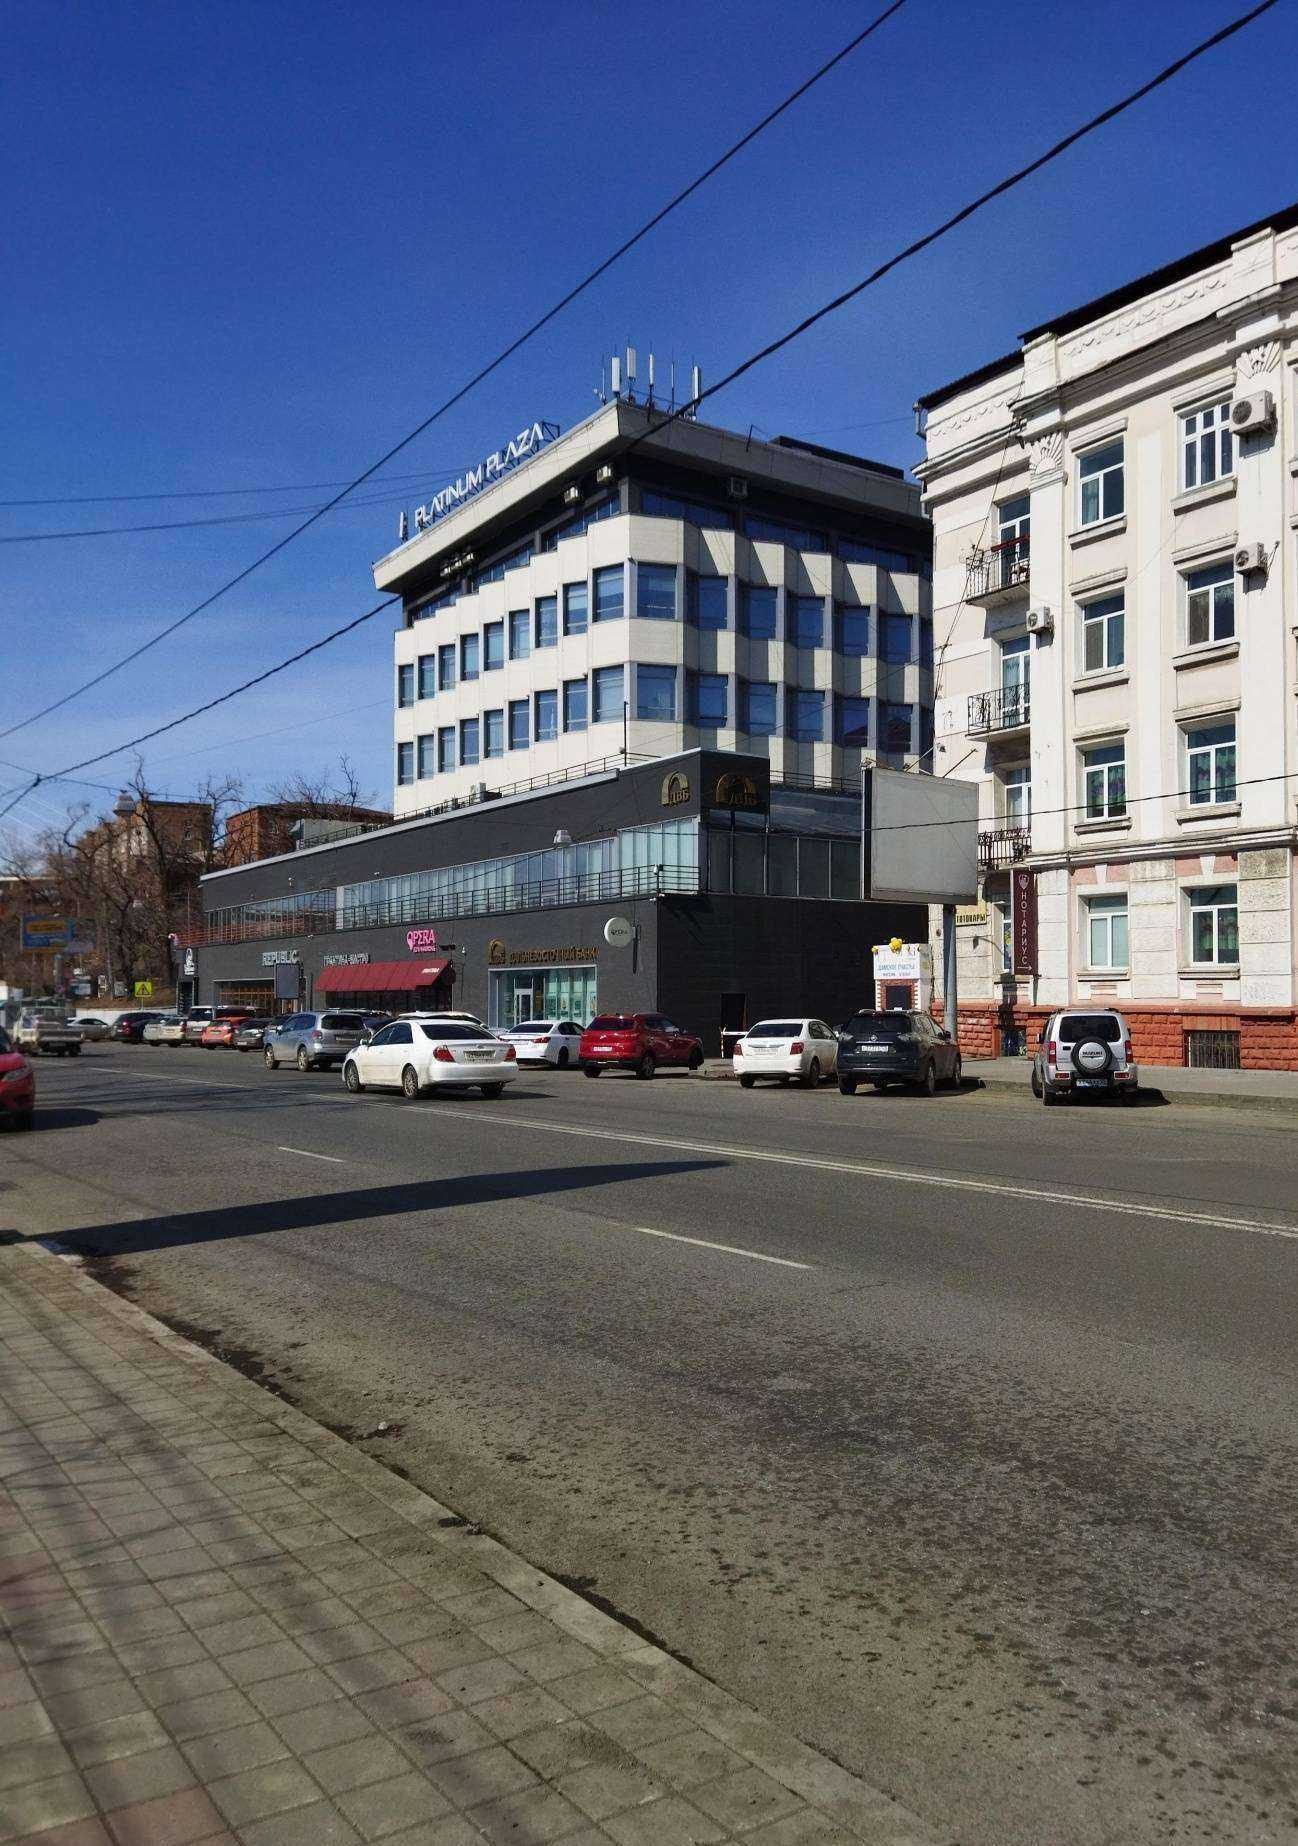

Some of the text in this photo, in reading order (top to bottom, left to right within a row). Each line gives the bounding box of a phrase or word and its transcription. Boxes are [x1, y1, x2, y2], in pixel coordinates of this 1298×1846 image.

[414, 422, 544, 529] PLATINUM PLAZA
[262, 949, 299, 966] REPUBLIC
[1021, 891, 1029, 965] НОТАРИУС
